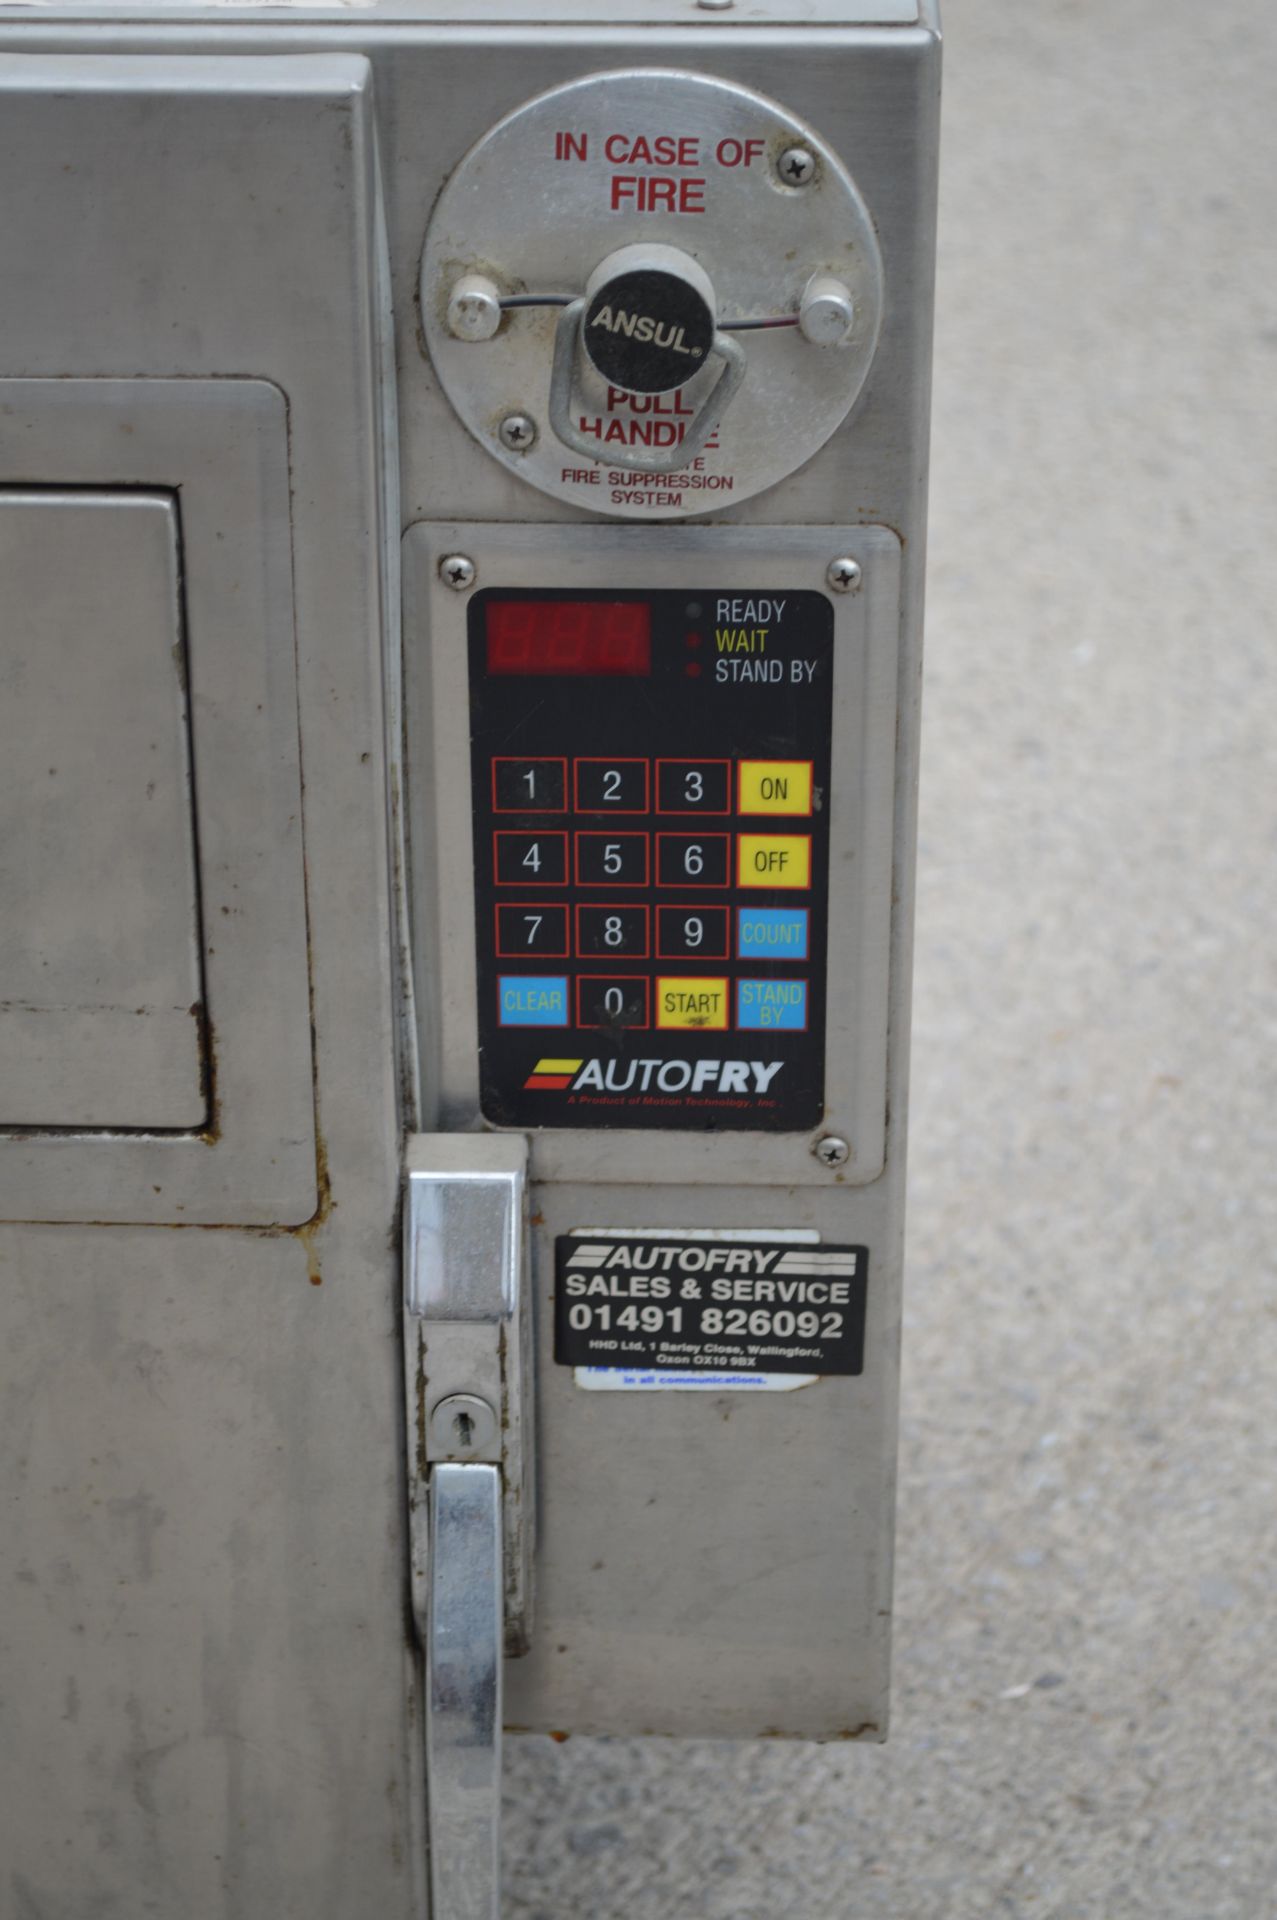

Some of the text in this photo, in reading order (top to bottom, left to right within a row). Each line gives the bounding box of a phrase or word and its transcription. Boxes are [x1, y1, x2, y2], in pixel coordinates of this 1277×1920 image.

[555, 132, 765, 167] IN CASE OF
[610, 175, 706, 213] FIRE
[607, 386, 694, 415] PULL
[561, 468, 734, 490] FIRE SUPPRESSION
[611, 490, 682, 506] SYSTEM
[716, 599, 787, 623] READY
[715, 629, 769, 653] WAIT
[715, 659, 817, 683] STAND BY
[522, 769, 537, 800] 1
[602, 770, 622, 801] 2
[684, 771, 703, 802] 3
[759, 777, 788, 801] ON
[522, 843, 542, 873] 4
[603, 844, 623, 874] 5
[684, 845, 703, 875] 6
[754, 850, 789, 873] OFF
[523, 916, 543, 945] 7
[604, 917, 623, 946] 8
[684, 917, 703, 947] 9
[741, 923, 802, 945] COUNT
[504, 990, 562, 1011] CLEAR
[603, 987, 624, 1015] 0
[664, 993, 721, 1014] START
[742, 983, 802, 1005] STAND
[760, 1006, 785, 1026] BY
[572, 1058, 784, 1094] AUTOFRY
[567, 1096, 576, 1105] A
[579, 1096, 625, 1105] Product
[628, 1096, 642, 1105] of
[642, 1096, 681, 1106] Motion
[685, 1097, 753, 1108] Technology,
[605, 1245, 780, 1274] AUTOFRY
[566, 1275, 850, 1305] SALES & SERVICE
[568, 1304, 844, 1339] 01491 826092
